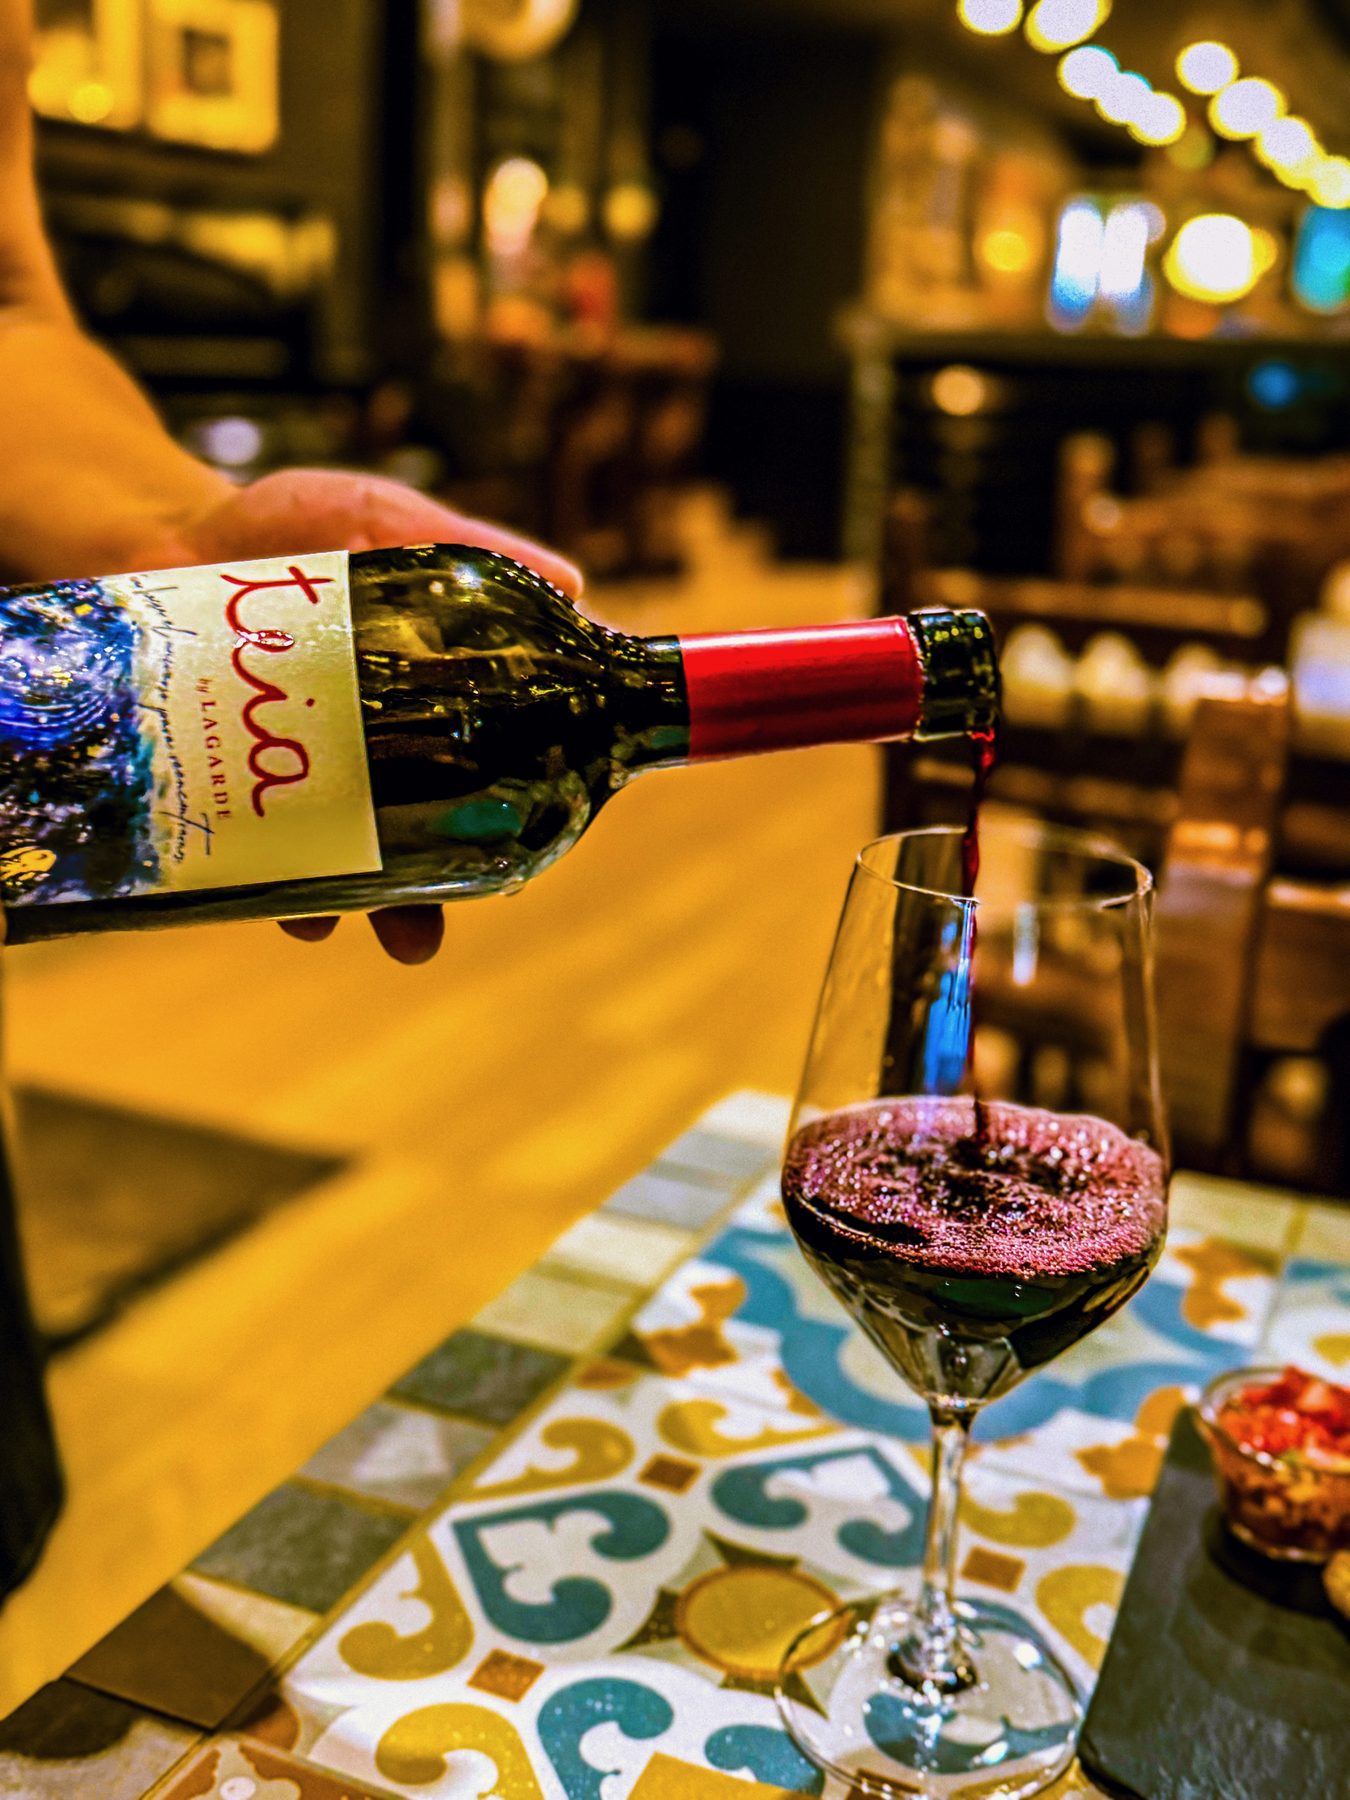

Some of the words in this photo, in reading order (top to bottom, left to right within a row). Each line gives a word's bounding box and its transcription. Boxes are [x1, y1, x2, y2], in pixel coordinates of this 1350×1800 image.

[195, 678, 213, 693] by
[220, 566, 334, 817] teia
[201, 701, 231, 819] LAGARDE
